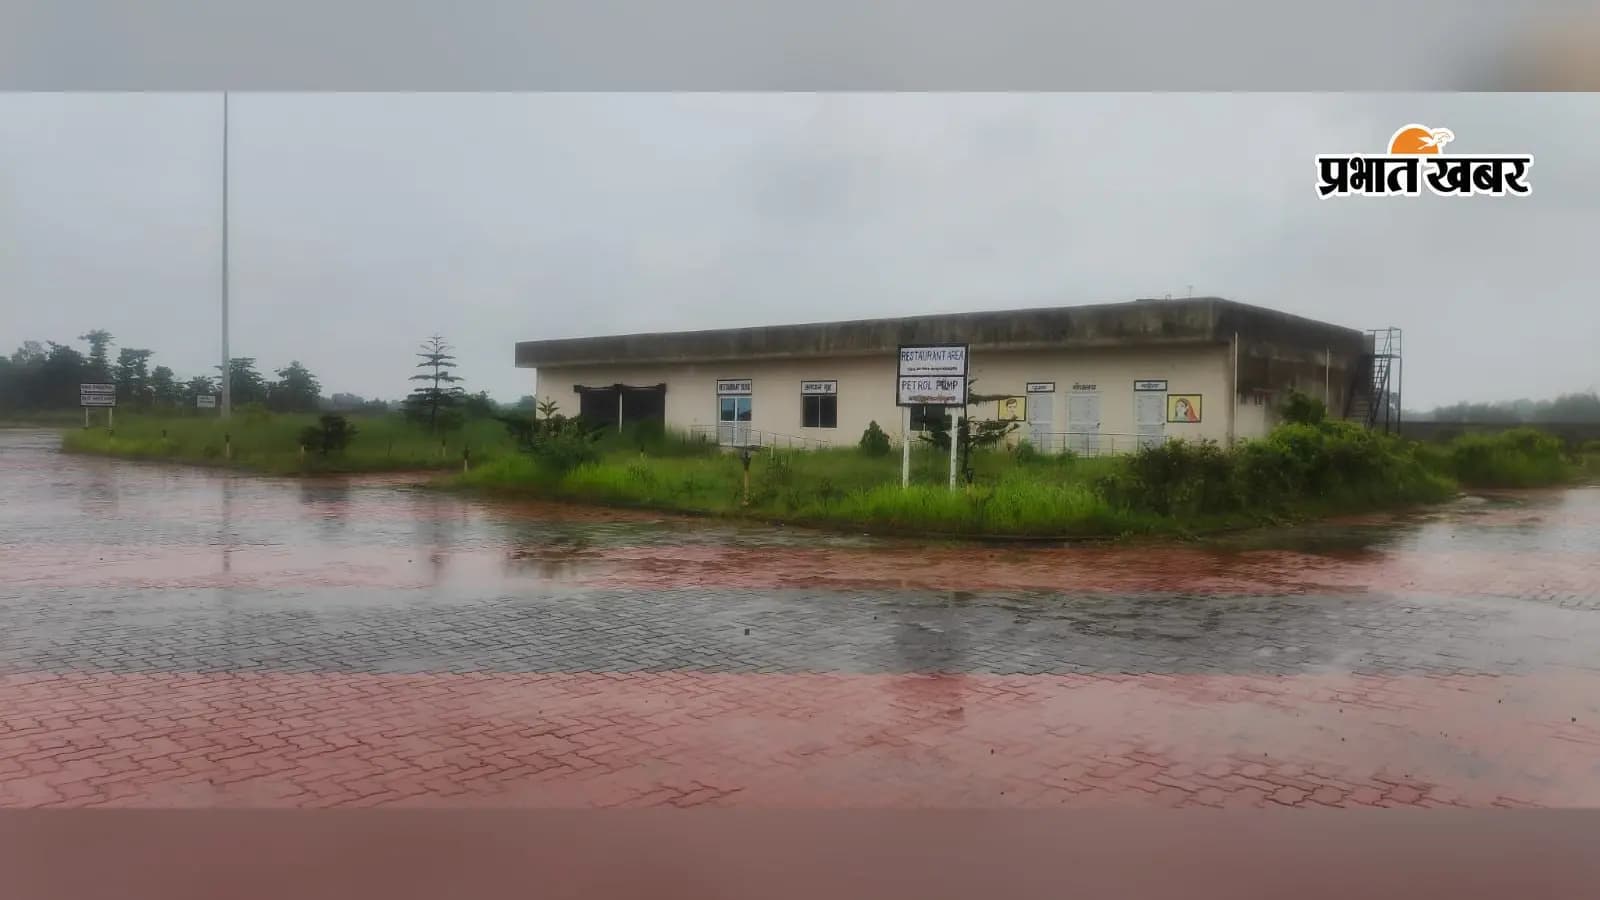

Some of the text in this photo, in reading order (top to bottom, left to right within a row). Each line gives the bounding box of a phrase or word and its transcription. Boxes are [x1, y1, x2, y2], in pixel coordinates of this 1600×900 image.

[901, 350, 964, 361] RESTAURANT AREA
[902, 379, 958, 390] PETROL PUMP
